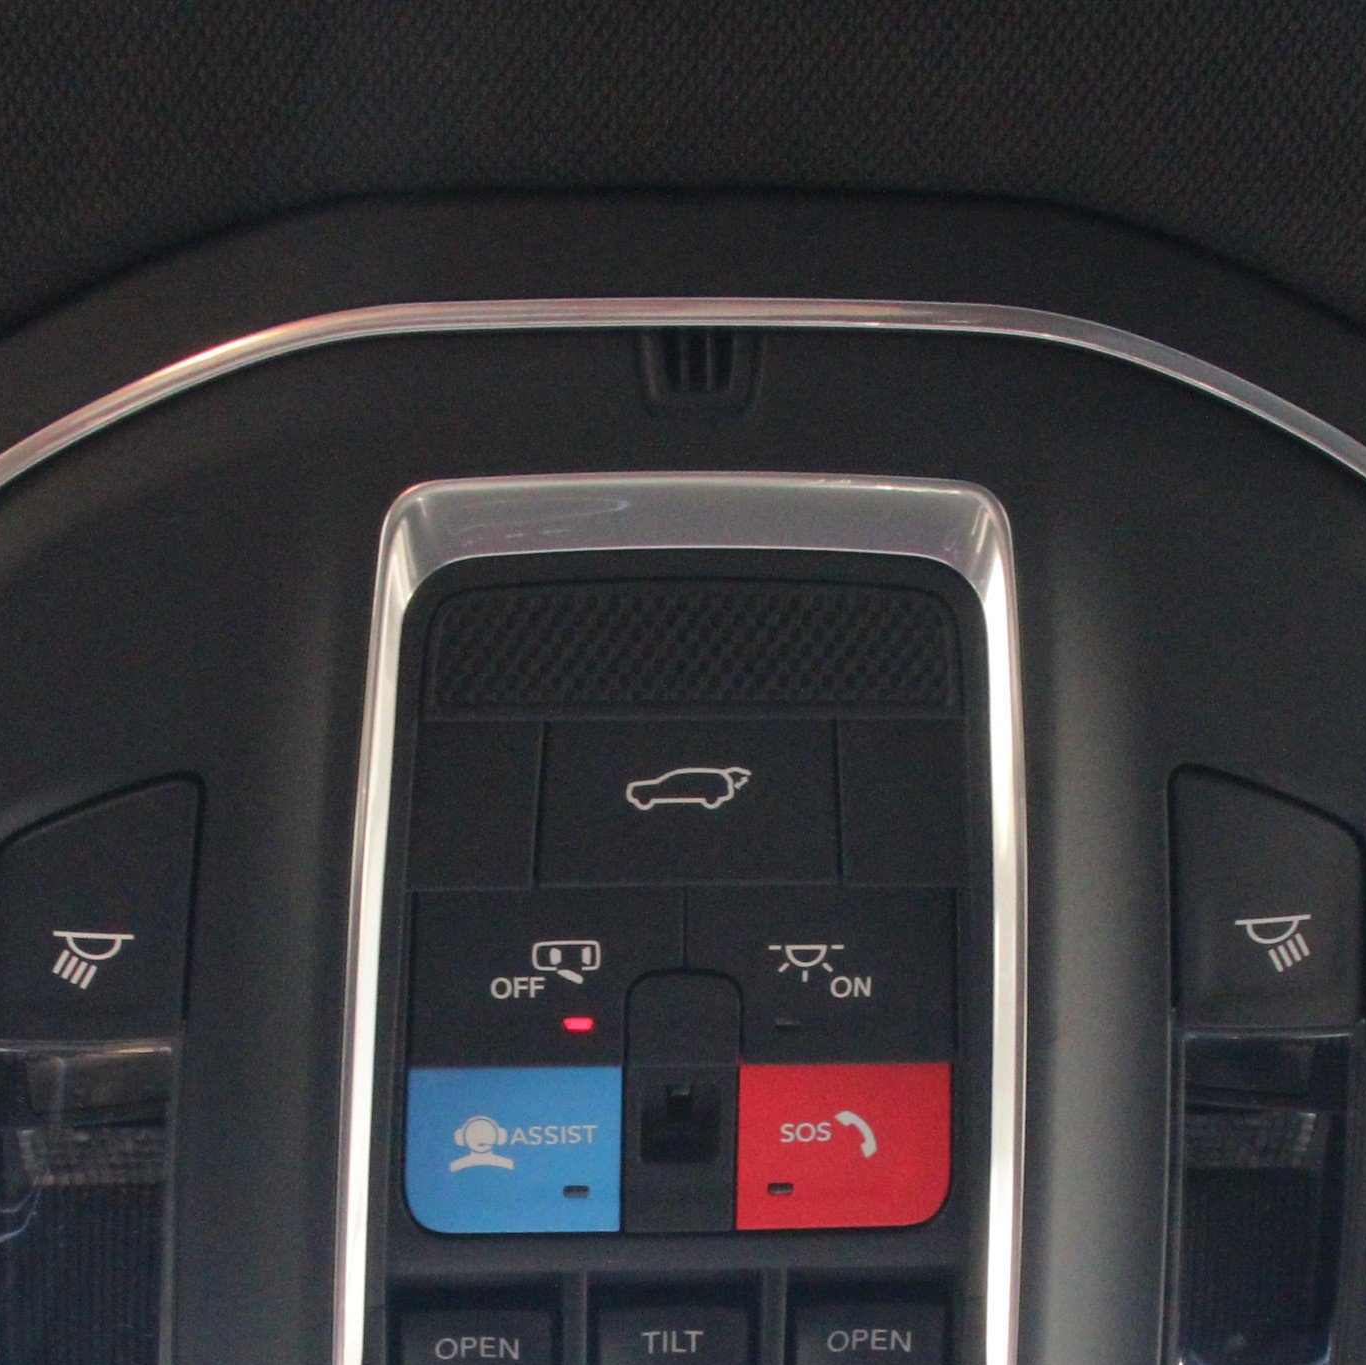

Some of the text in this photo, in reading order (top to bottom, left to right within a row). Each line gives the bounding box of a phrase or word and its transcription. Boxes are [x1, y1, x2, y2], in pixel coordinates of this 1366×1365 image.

[490, 976, 546, 1000] OFF
[829, 975, 872, 999] ON
[510, 1124, 598, 1146] ASSIST
[780, 1121, 832, 1144] SOS
[434, 1336, 520, 1361] OPEN
[641, 1329, 704, 1354] TILT
[826, 1328, 912, 1353] OPEN
